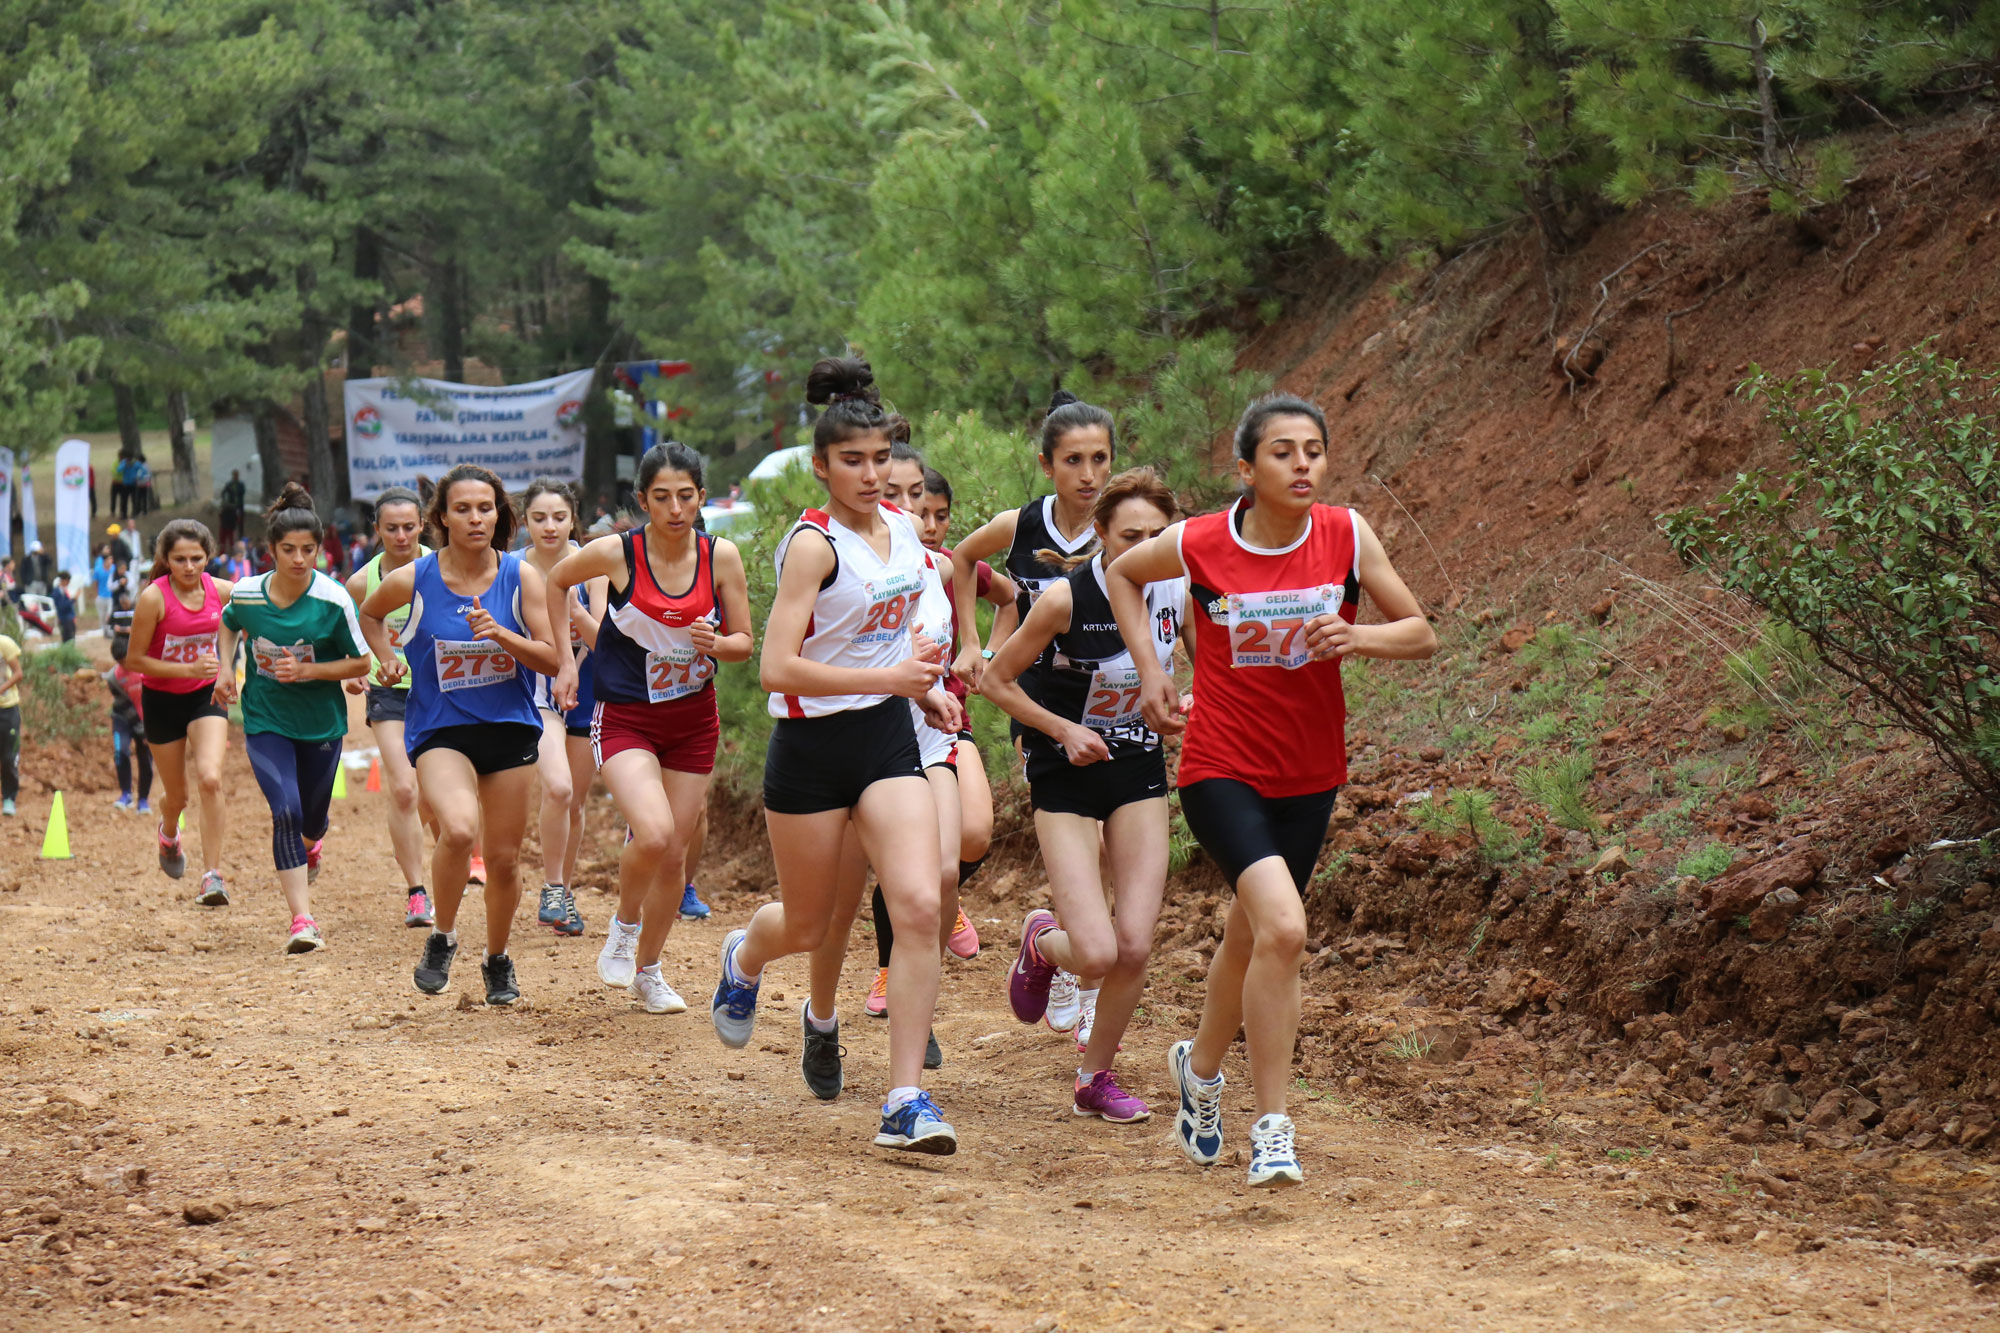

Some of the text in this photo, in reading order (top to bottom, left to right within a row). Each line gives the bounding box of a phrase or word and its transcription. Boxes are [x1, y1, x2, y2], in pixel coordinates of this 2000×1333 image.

[1266, 594, 1299, 604] GEDİZ
[1239, 603, 1325, 619] KAYMAKAMLIĞI
[1083, 623, 1118, 631] KRTLYVS
[1236, 615, 1316, 655] 27
[440, 653, 514, 681] 279
[1238, 653, 1308, 668] GEDİZ BELEDİ
[442, 679, 467, 690] GEDİZ
[652, 690, 676, 700] GEDİZ
[1087, 685, 1142, 718] 27
